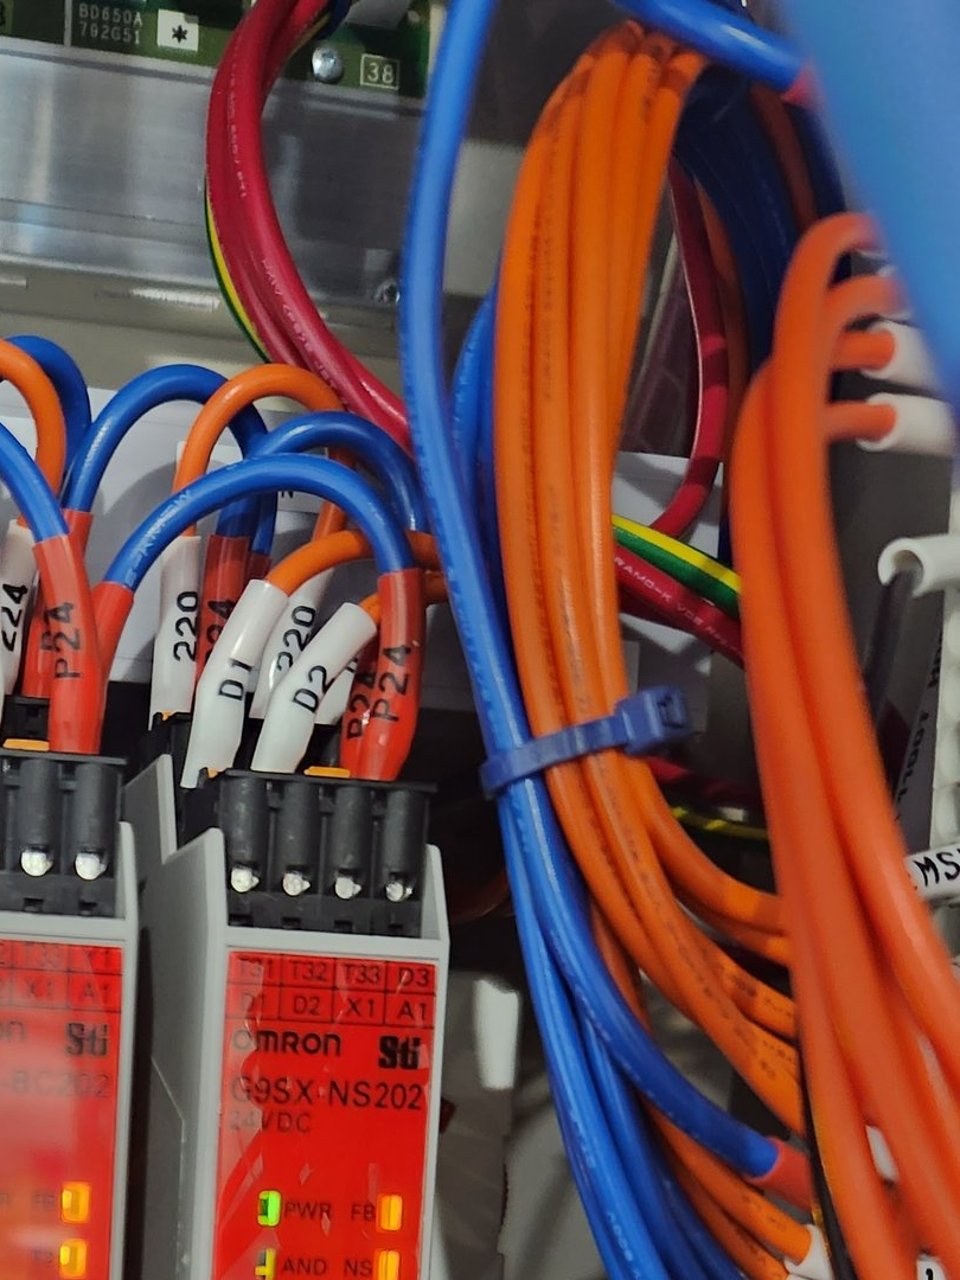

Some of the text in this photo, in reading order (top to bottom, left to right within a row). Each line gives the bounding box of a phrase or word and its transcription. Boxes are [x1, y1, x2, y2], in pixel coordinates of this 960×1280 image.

[367, 61, 395, 83] 38
[53, 601, 84, 680] P24
[173, 590, 199, 663] 220
[292, 664, 335, 714] D2
[371, 643, 413, 724] P24
[912, 847, 960, 888] MS
[288, 959, 328, 982] T32
[342, 962, 381, 984] T33
[397, 966, 431, 987] D3
[292, 995, 321, 1016] D2
[344, 998, 376, 1018] X1
[399, 1001, 428, 1021] A1
[283, 1201, 376, 1222] PWR FB
[281, 1257, 373, 1278] AND NS
